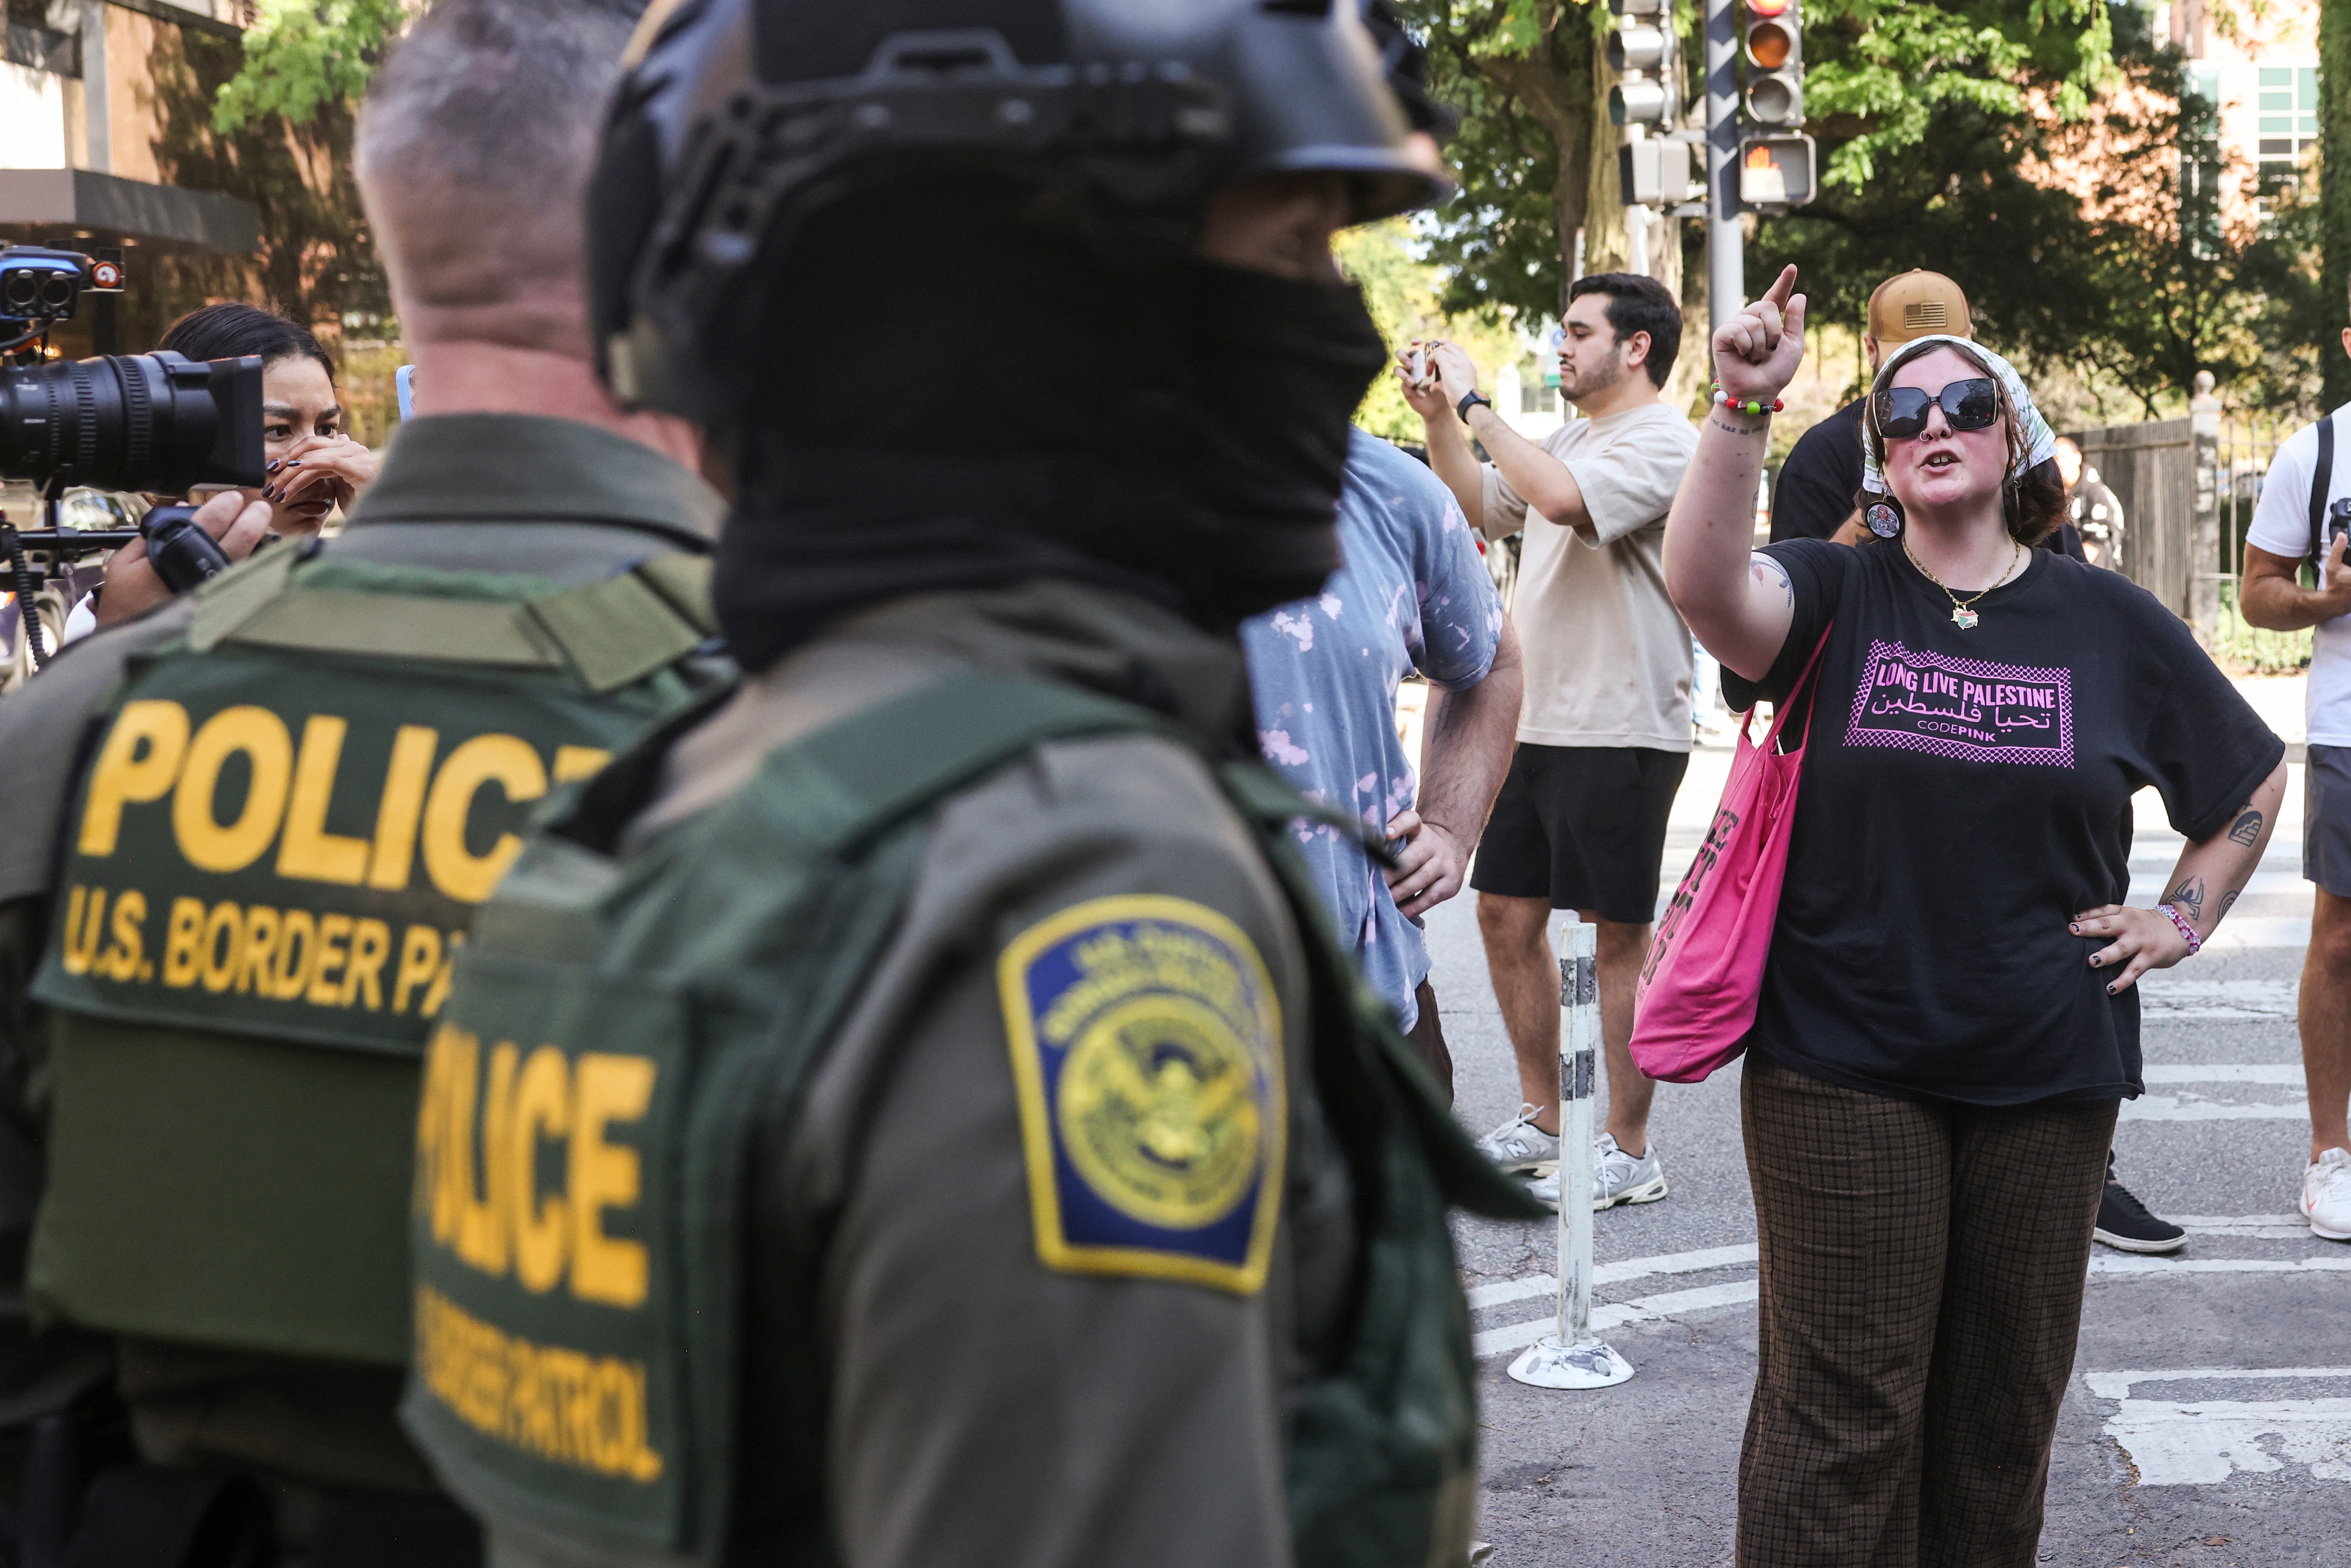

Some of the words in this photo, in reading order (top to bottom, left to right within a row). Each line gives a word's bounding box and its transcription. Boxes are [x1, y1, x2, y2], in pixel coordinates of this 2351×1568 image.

[1876, 662, 1918, 692] LONG
[1922, 672, 1963, 699] LIVE
[1963, 680, 2056, 709] PALESTINE
[1871, 692, 1982, 723] فلسطين
[1995, 707, 2051, 733] تحيا
[1917, 720, 1996, 742] CODEPINK
[77, 699, 613, 904] POLIC
[63, 884, 154, 983] U.S.
[164, 895, 391, 1012] BORDER
[1504, 1138, 1531, 1159] N
